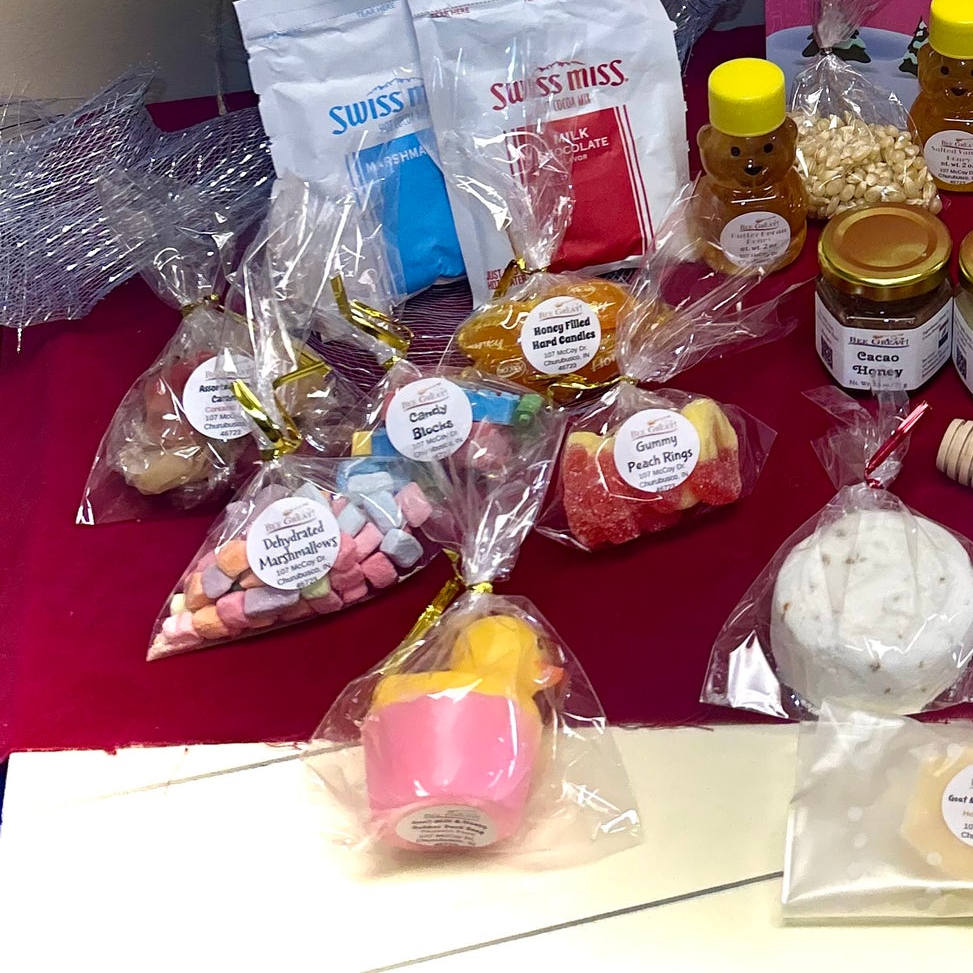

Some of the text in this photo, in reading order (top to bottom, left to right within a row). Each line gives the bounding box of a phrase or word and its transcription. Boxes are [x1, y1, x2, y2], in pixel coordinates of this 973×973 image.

[490, 74, 564, 111] SWSS
[578, 93, 591, 106] MIX
[329, 91, 404, 135] SWISS
[554, 128, 589, 144] MILK
[551, 136, 609, 156] OCOLATE
[366, 146, 426, 173] MARSHMA
[510, 276, 526, 286] ATER
[534, 317, 590, 336] Honey Filled
[532, 331, 596, 350] Hard Candies
[557, 348, 578, 357] McCoy
[857, 351, 899, 362] Cacao
[853, 365, 903, 378] Honey
[409, 404, 447, 422] Candy
[412, 420, 454, 440] Blocks
[636, 436, 677, 452] Gummy
[627, 449, 693, 473] Peach Rings
[263, 520, 324, 550] Dehydrated
[259, 536, 338, 570] Marshmallows
[948, 794, 967, 803] Goat
